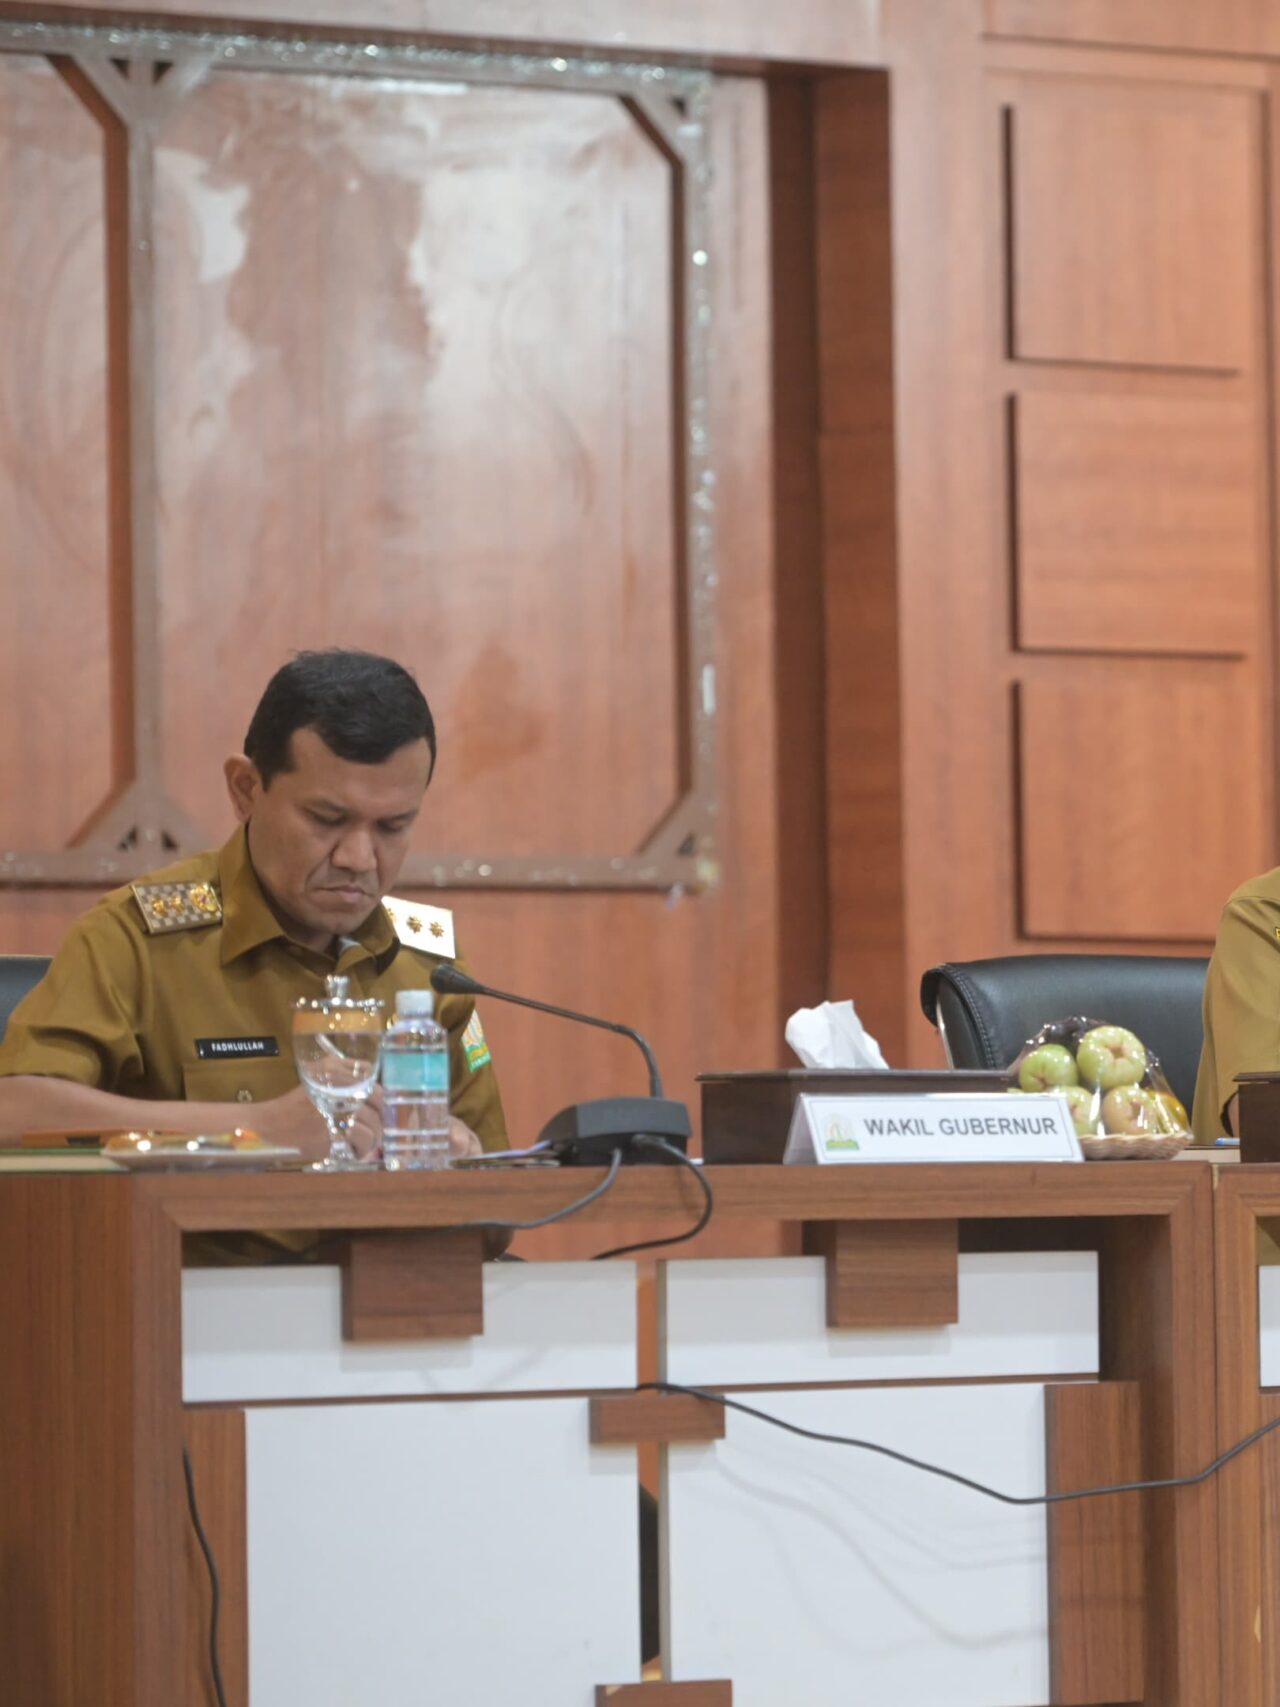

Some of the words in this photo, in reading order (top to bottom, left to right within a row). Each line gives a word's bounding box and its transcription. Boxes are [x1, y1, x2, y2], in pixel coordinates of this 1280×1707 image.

[211, 1041, 264, 1052] FADHLULLAH
[863, 1118, 934, 1137] WAKIL
[939, 1117, 1058, 1136] GUBERNUR
